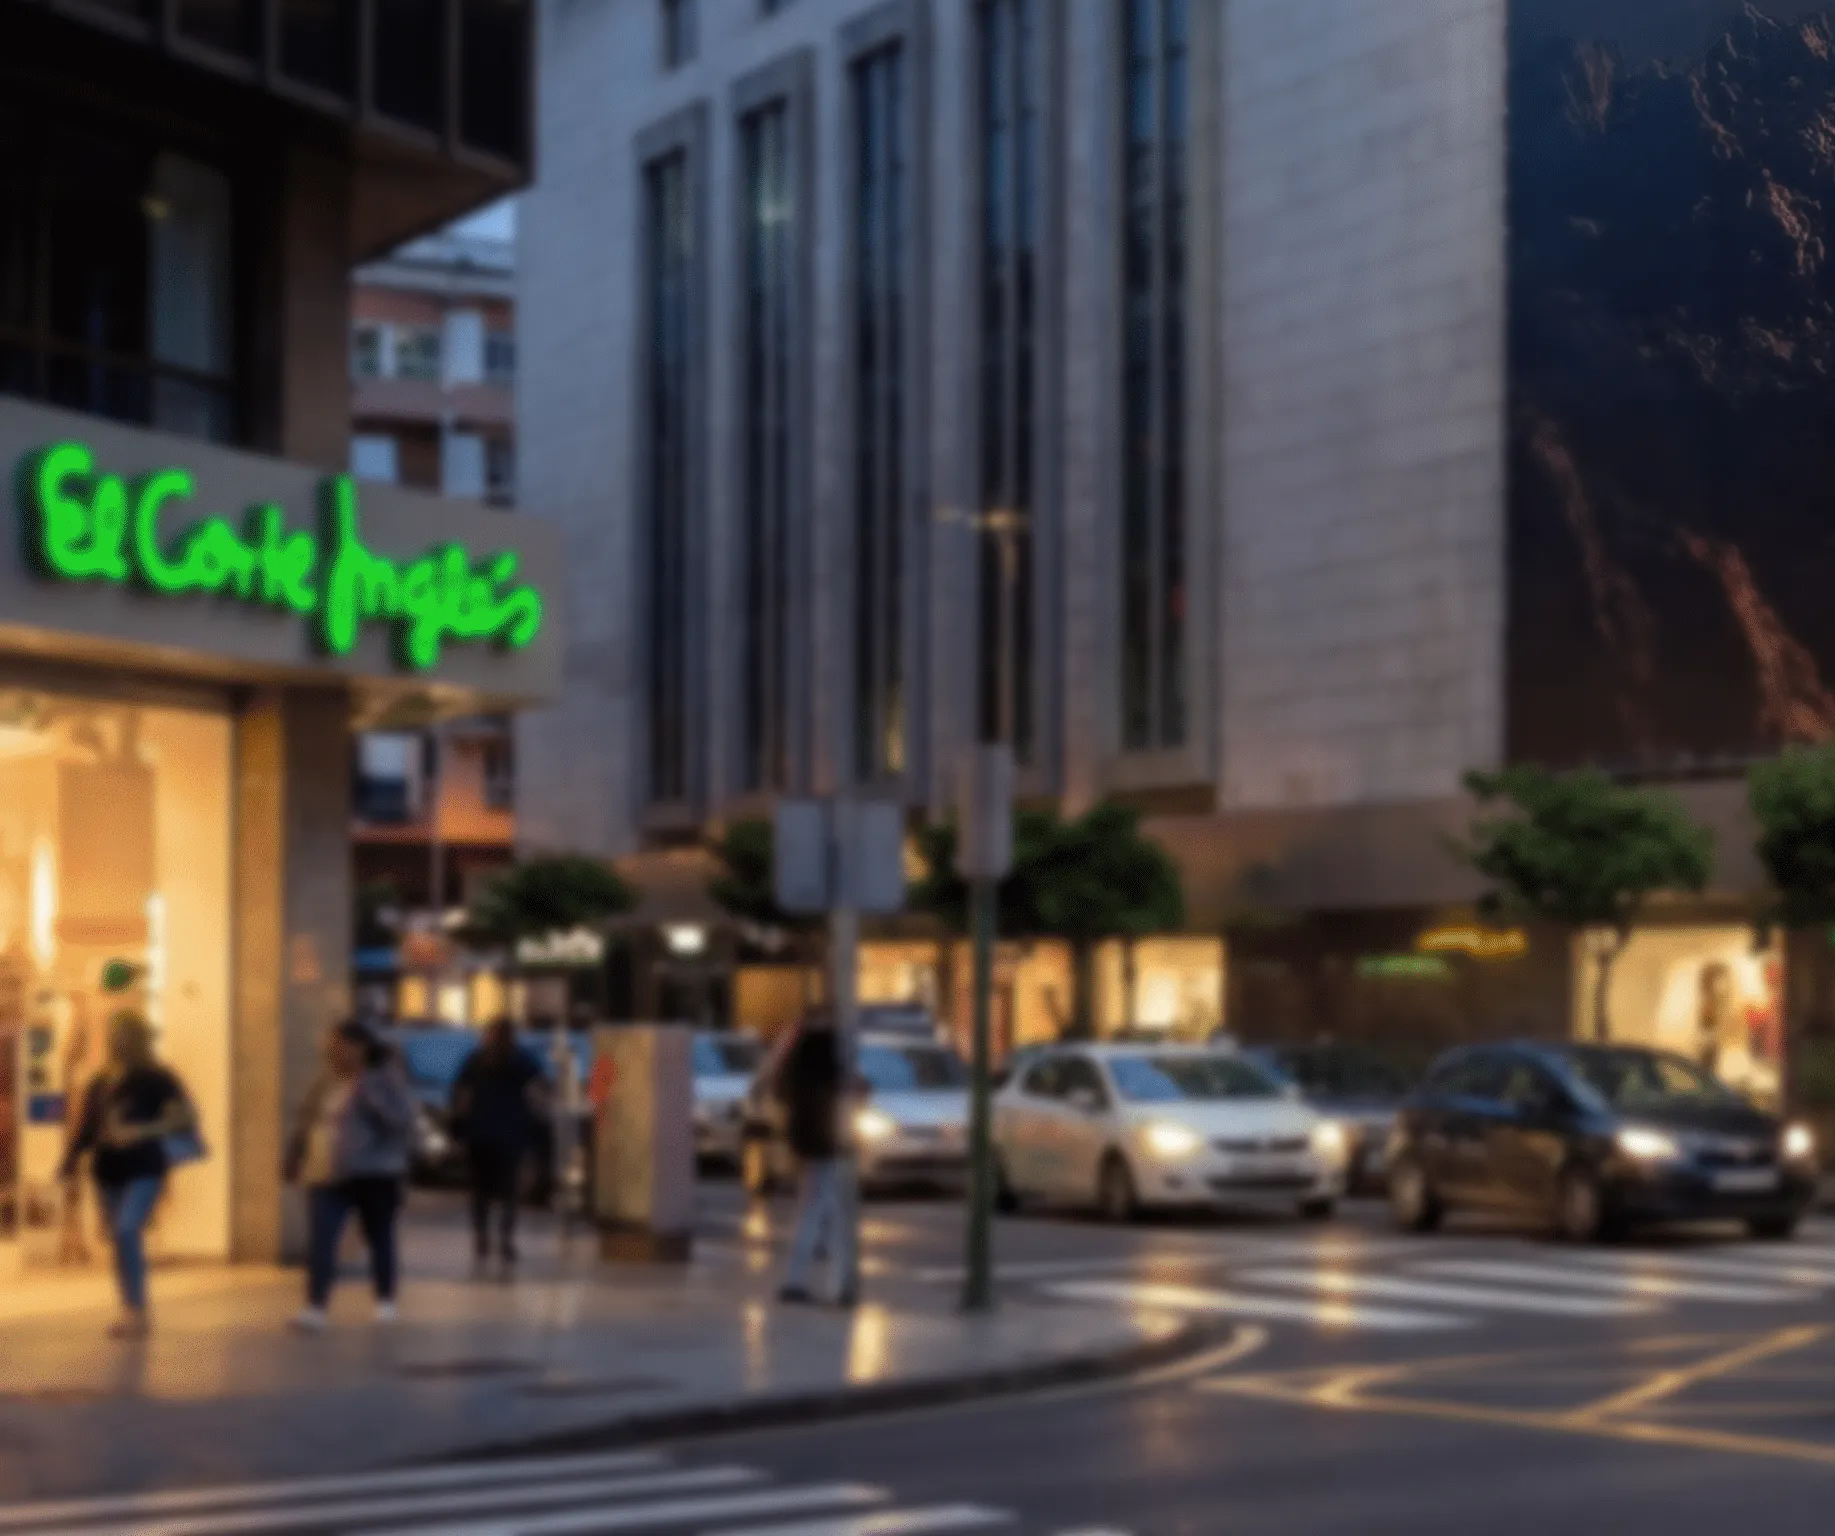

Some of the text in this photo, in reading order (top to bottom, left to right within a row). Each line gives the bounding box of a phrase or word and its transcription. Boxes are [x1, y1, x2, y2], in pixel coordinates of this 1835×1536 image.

[39, 441, 544, 669] El Corte Inglés
